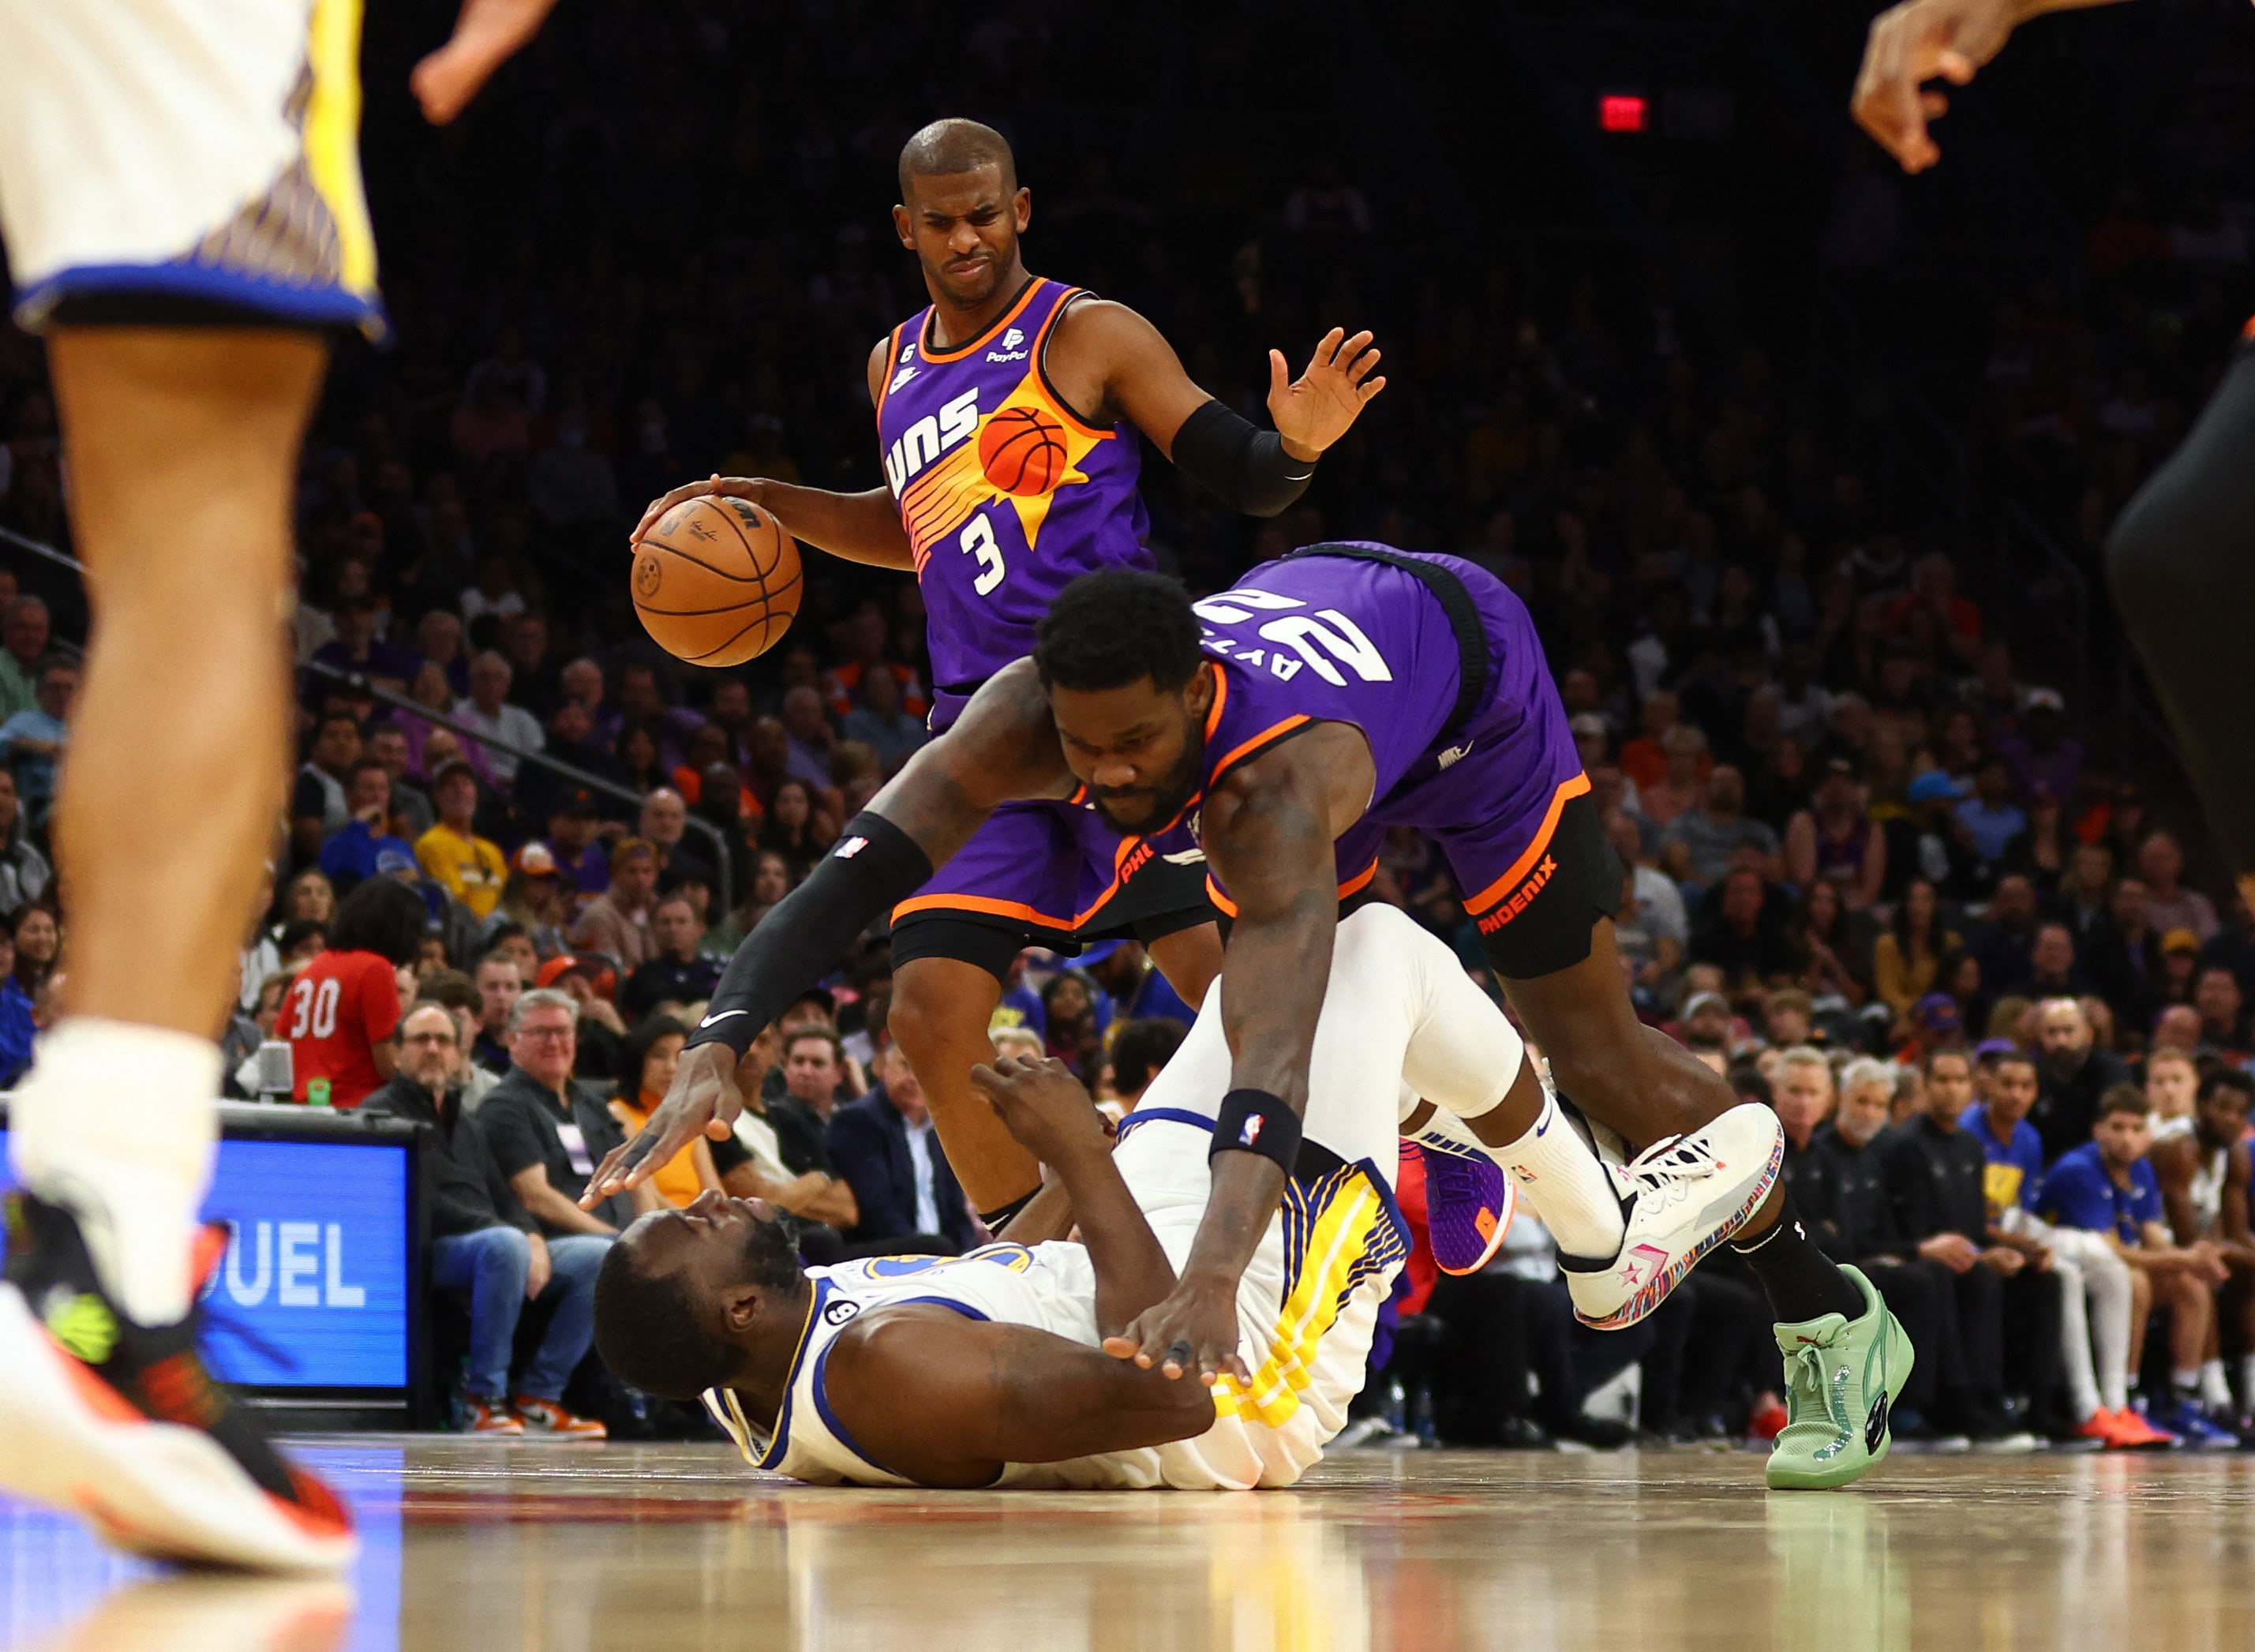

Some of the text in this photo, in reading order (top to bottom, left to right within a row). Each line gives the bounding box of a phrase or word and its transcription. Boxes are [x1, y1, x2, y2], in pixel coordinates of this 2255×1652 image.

[900, 343, 916, 363] 6
[986, 350, 1028, 363] PayPal
[960, 512, 1006, 596] 3
[1198, 627, 1303, 682] AYT
[1477, 853, 1559, 936] PHOENIX
[290, 977, 341, 1040] 30
[199, 1220, 366, 1308] UEL
